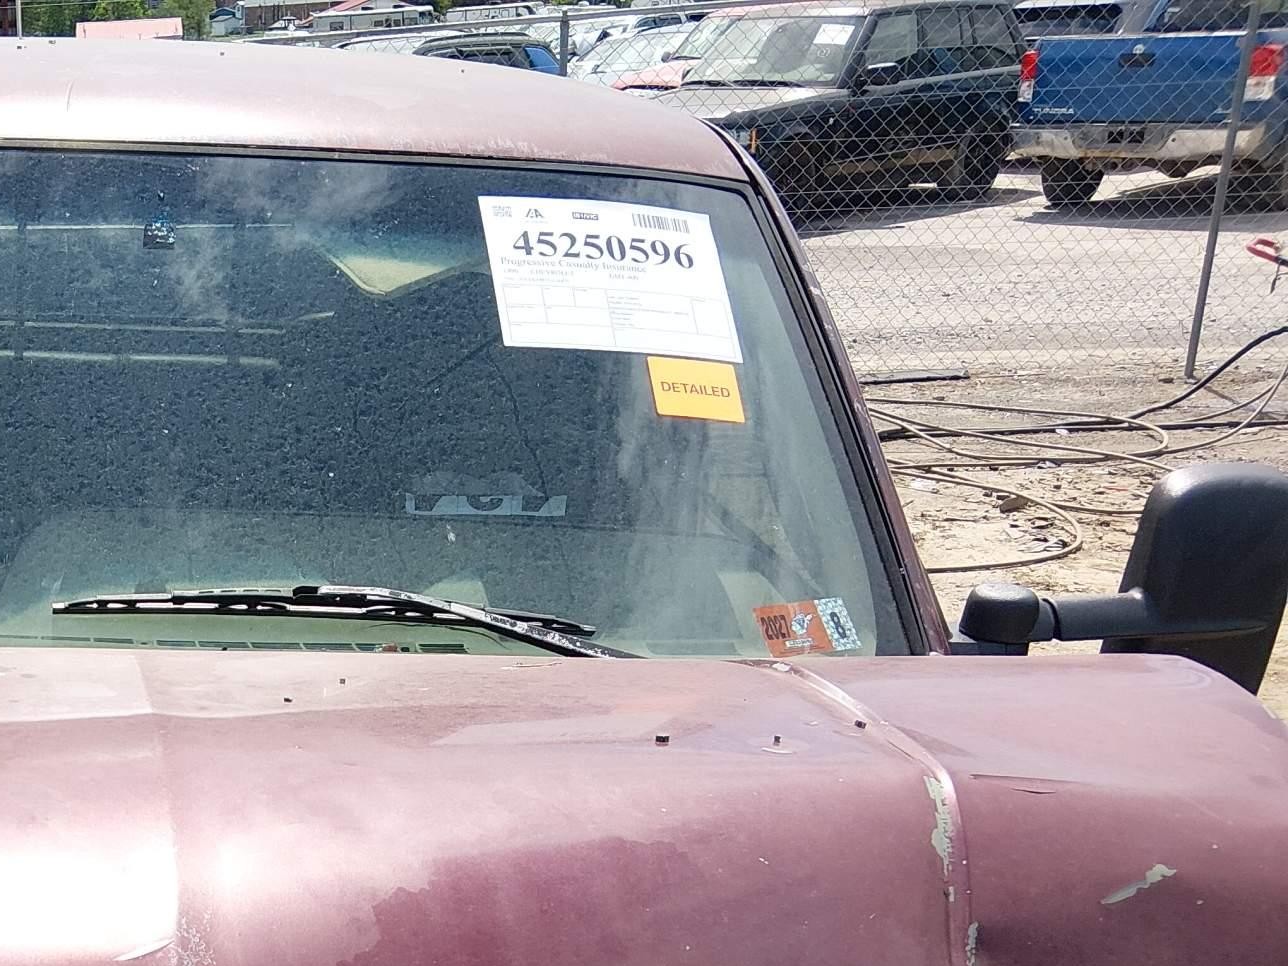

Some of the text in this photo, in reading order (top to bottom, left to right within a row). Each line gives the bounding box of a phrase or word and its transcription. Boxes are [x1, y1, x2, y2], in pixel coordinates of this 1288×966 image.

[512, 230, 694, 269] 45250596
[500, 256, 647, 273] Progressive Casualty Insurance
[660, 381, 731, 398] DETAILED
[760, 611, 847, 640] 2027 8
